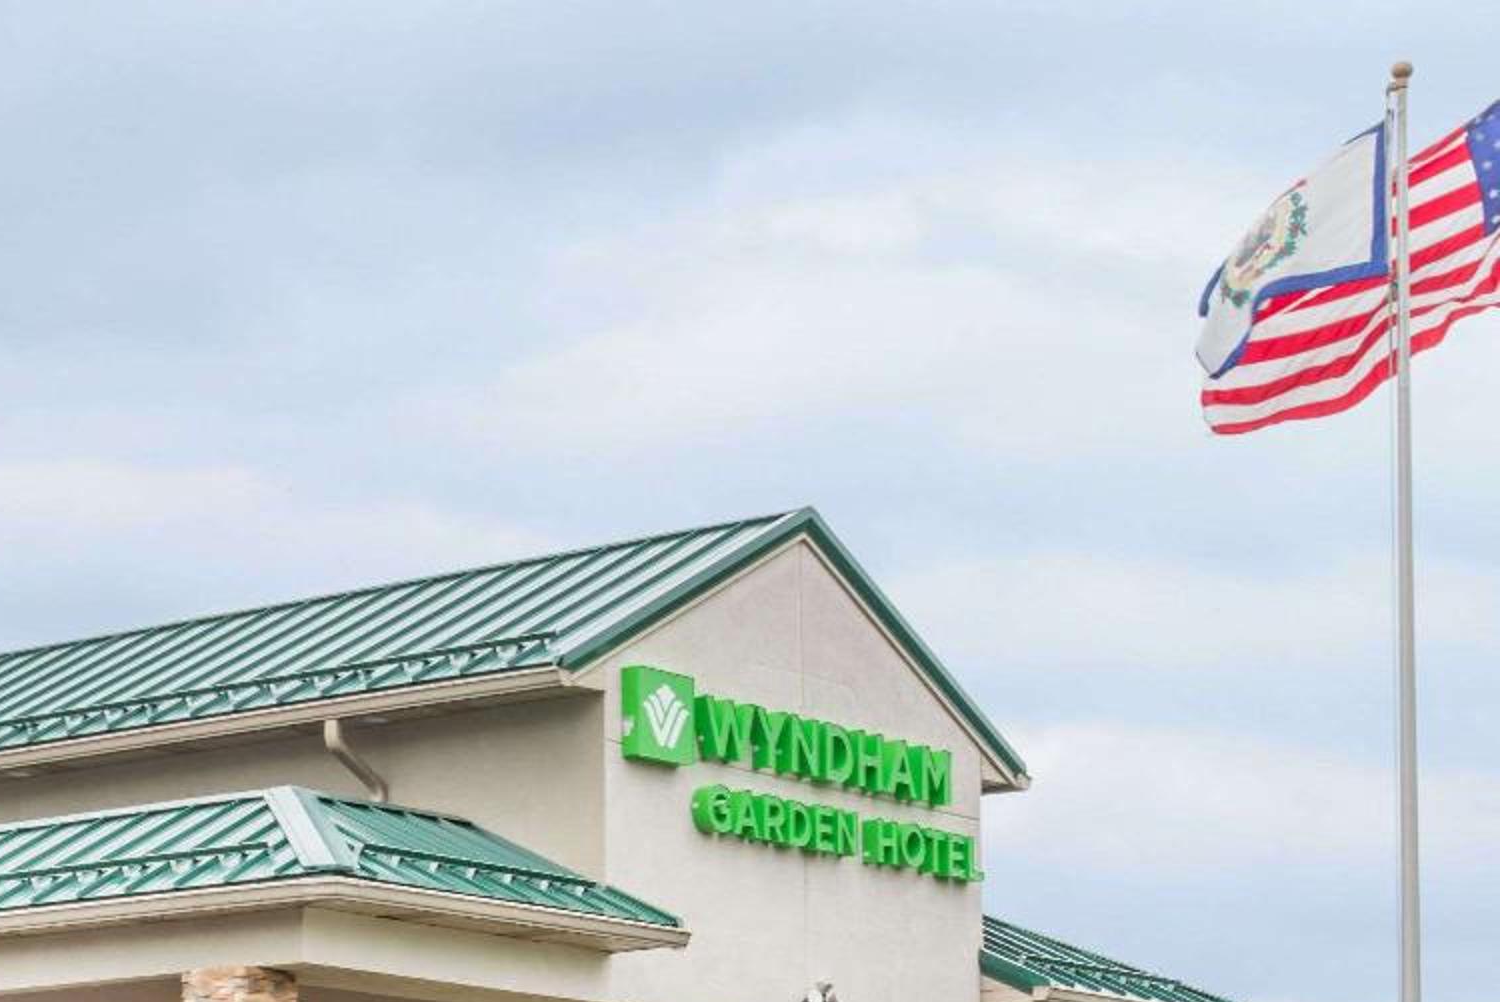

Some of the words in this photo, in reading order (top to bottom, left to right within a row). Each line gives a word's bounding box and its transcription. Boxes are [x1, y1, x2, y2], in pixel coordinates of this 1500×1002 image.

[696, 695, 951, 806] WYNDHAM
[693, 785, 858, 857] GARDEN
[863, 818, 985, 882] HOTEL
